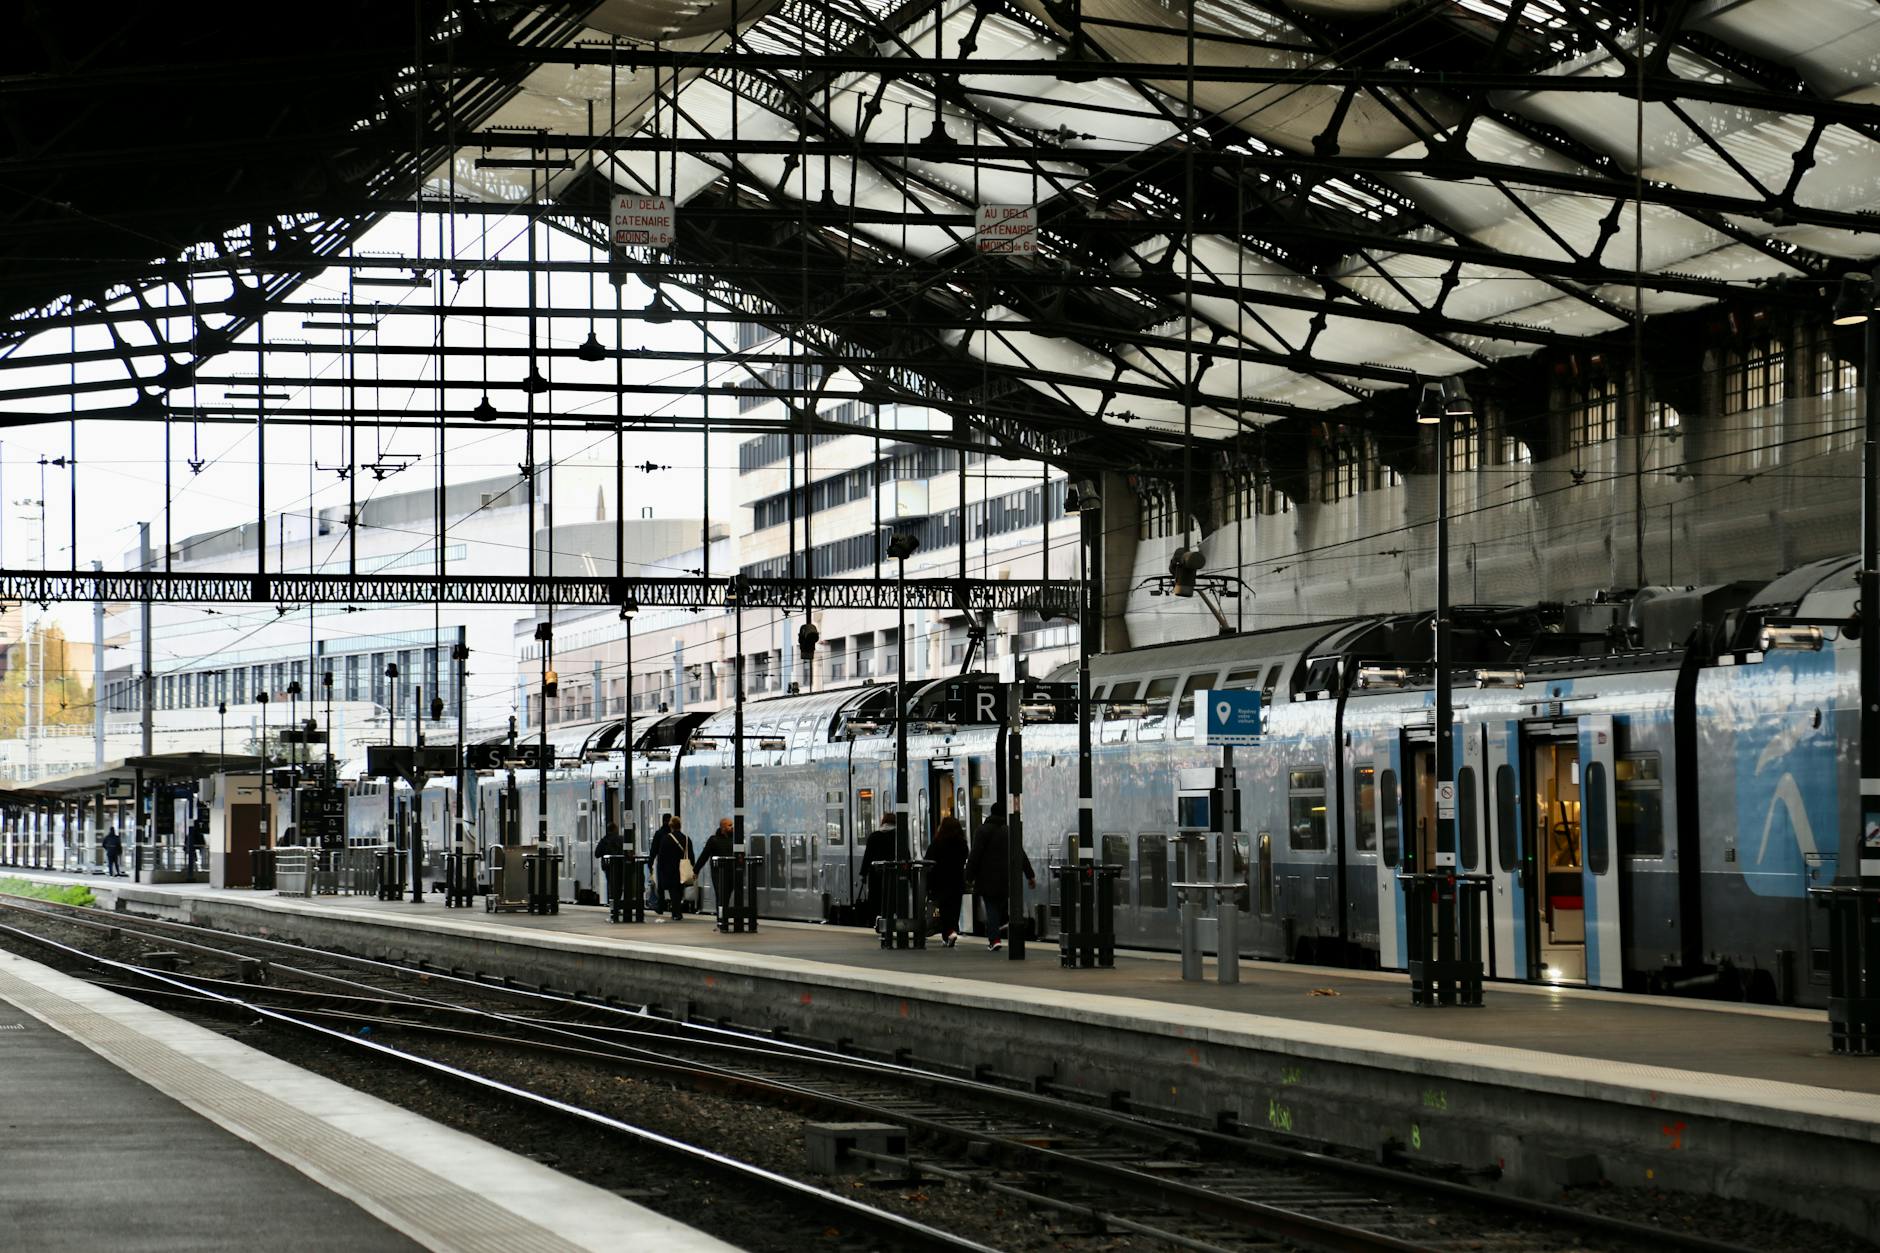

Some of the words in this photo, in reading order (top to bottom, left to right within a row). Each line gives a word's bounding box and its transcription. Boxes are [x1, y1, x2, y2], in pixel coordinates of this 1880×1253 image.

[620, 199, 633, 209] AU
[640, 199, 665, 210] DELA
[984, 208, 997, 219] AU
[1003, 208, 1028, 219] DELA
[615, 215, 670, 227] CATENAIRE
[980, 224, 1033, 235] CATENAIRE
[618, 231, 648, 243] MOINS
[983, 240, 1011, 251] MOINS
[976, 693, 998, 721] R
[489, 750, 501, 768] S
[287, 774, 297, 787] T
